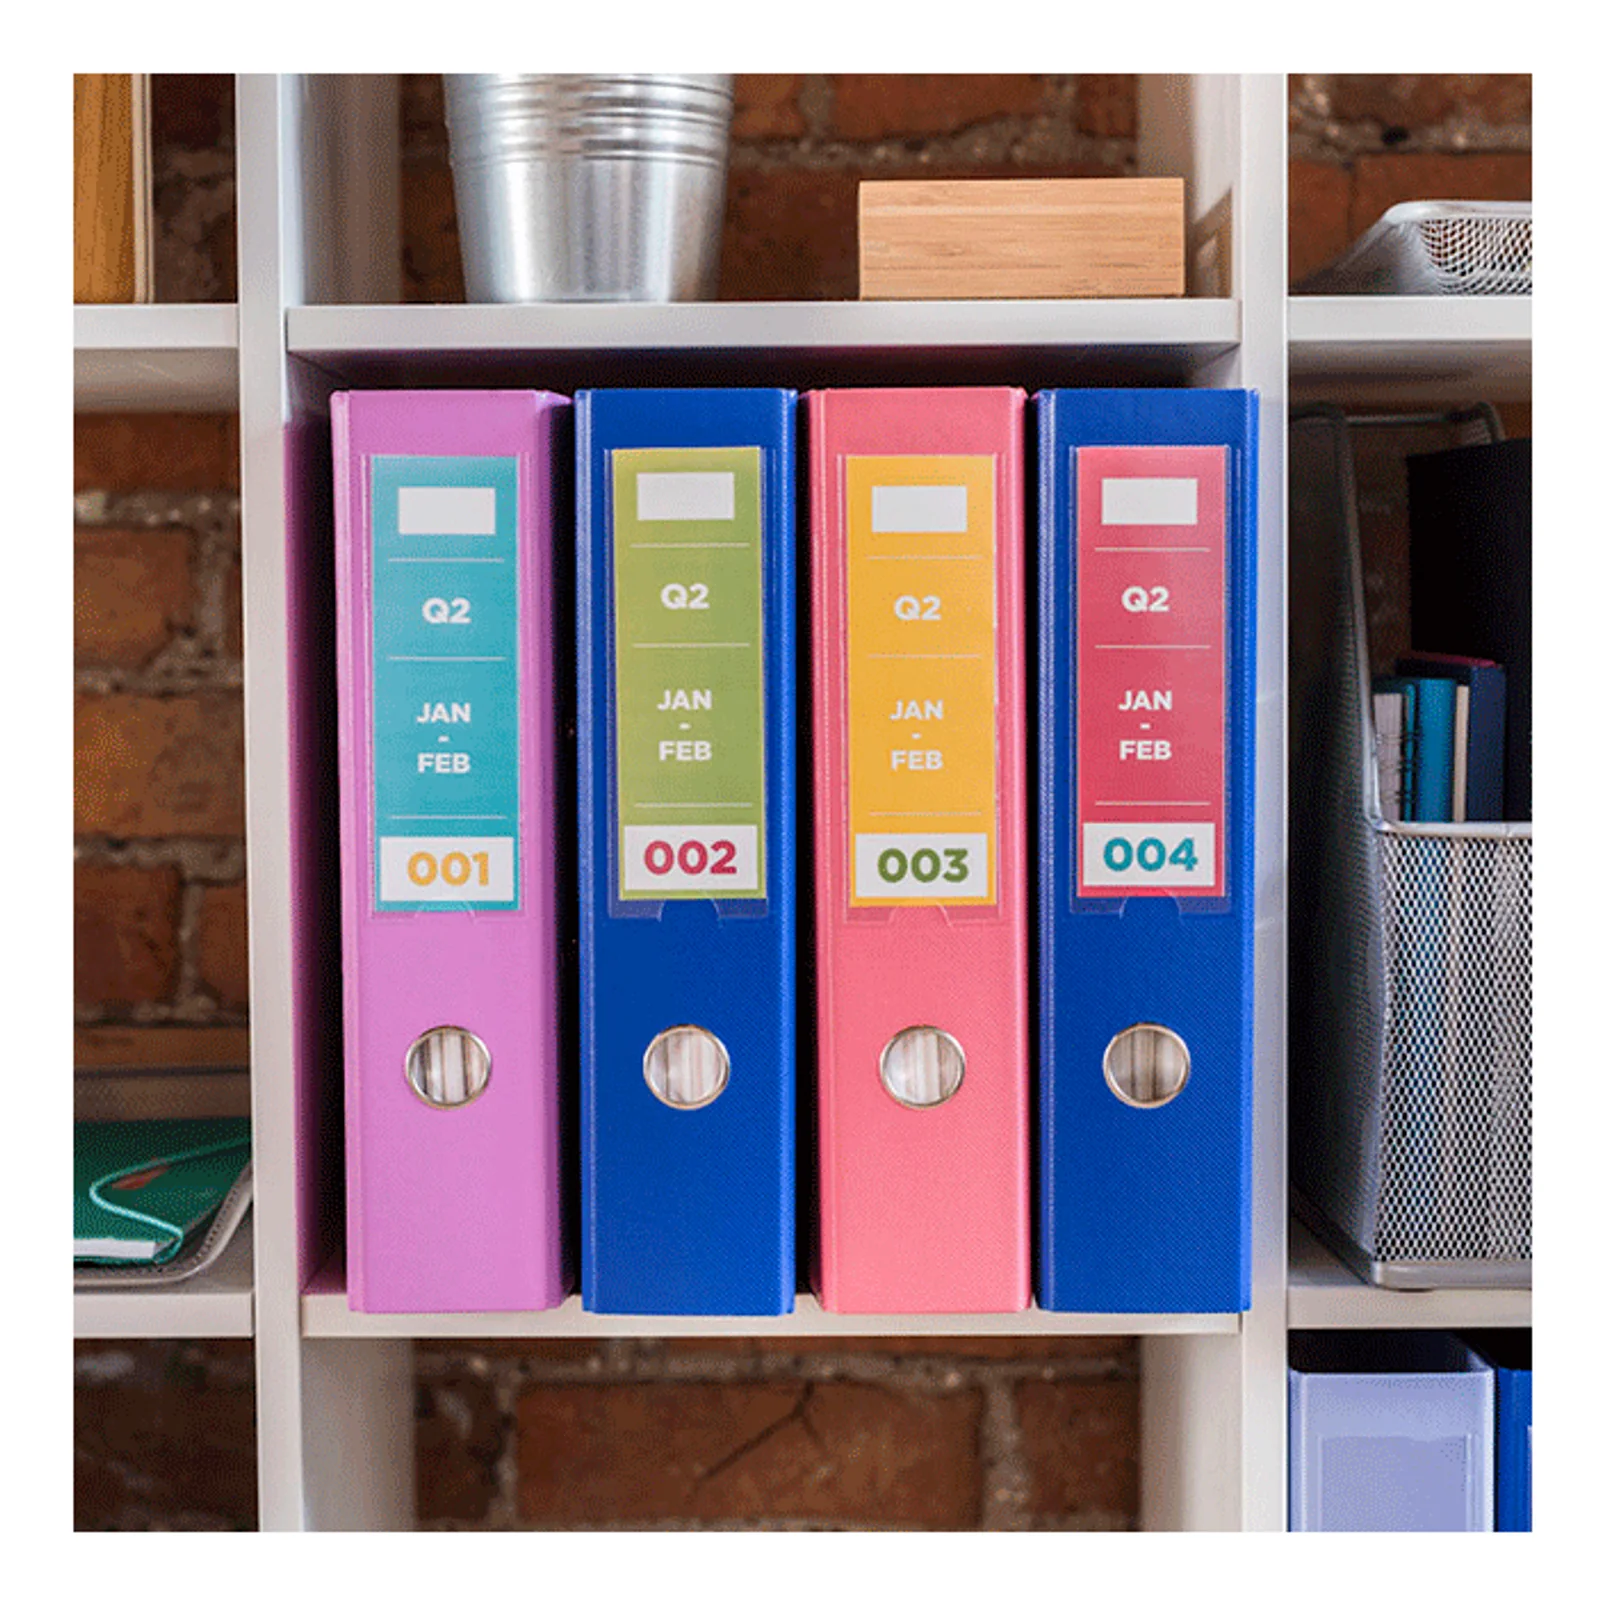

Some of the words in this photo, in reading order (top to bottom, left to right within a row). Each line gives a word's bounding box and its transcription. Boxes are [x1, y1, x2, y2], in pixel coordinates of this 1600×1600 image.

[660, 583, 710, 610] Q2
[894, 594, 942, 621] Q2
[1121, 586, 1170, 612] Q2
[421, 597, 471, 624] Q2
[657, 689, 712, 711] JAN
[889, 699, 944, 720] JAN
[1118, 690, 1173, 711] JAN
[416, 702, 471, 724] JAN
[658, 740, 712, 762] FEB
[891, 749, 944, 771] FEB
[1119, 739, 1172, 761] FEB
[417, 752, 471, 774] FEB
[643, 839, 738, 875] 002
[877, 848, 969, 884] 003
[1103, 837, 1199, 872] 004
[407, 851, 489, 887] 001
